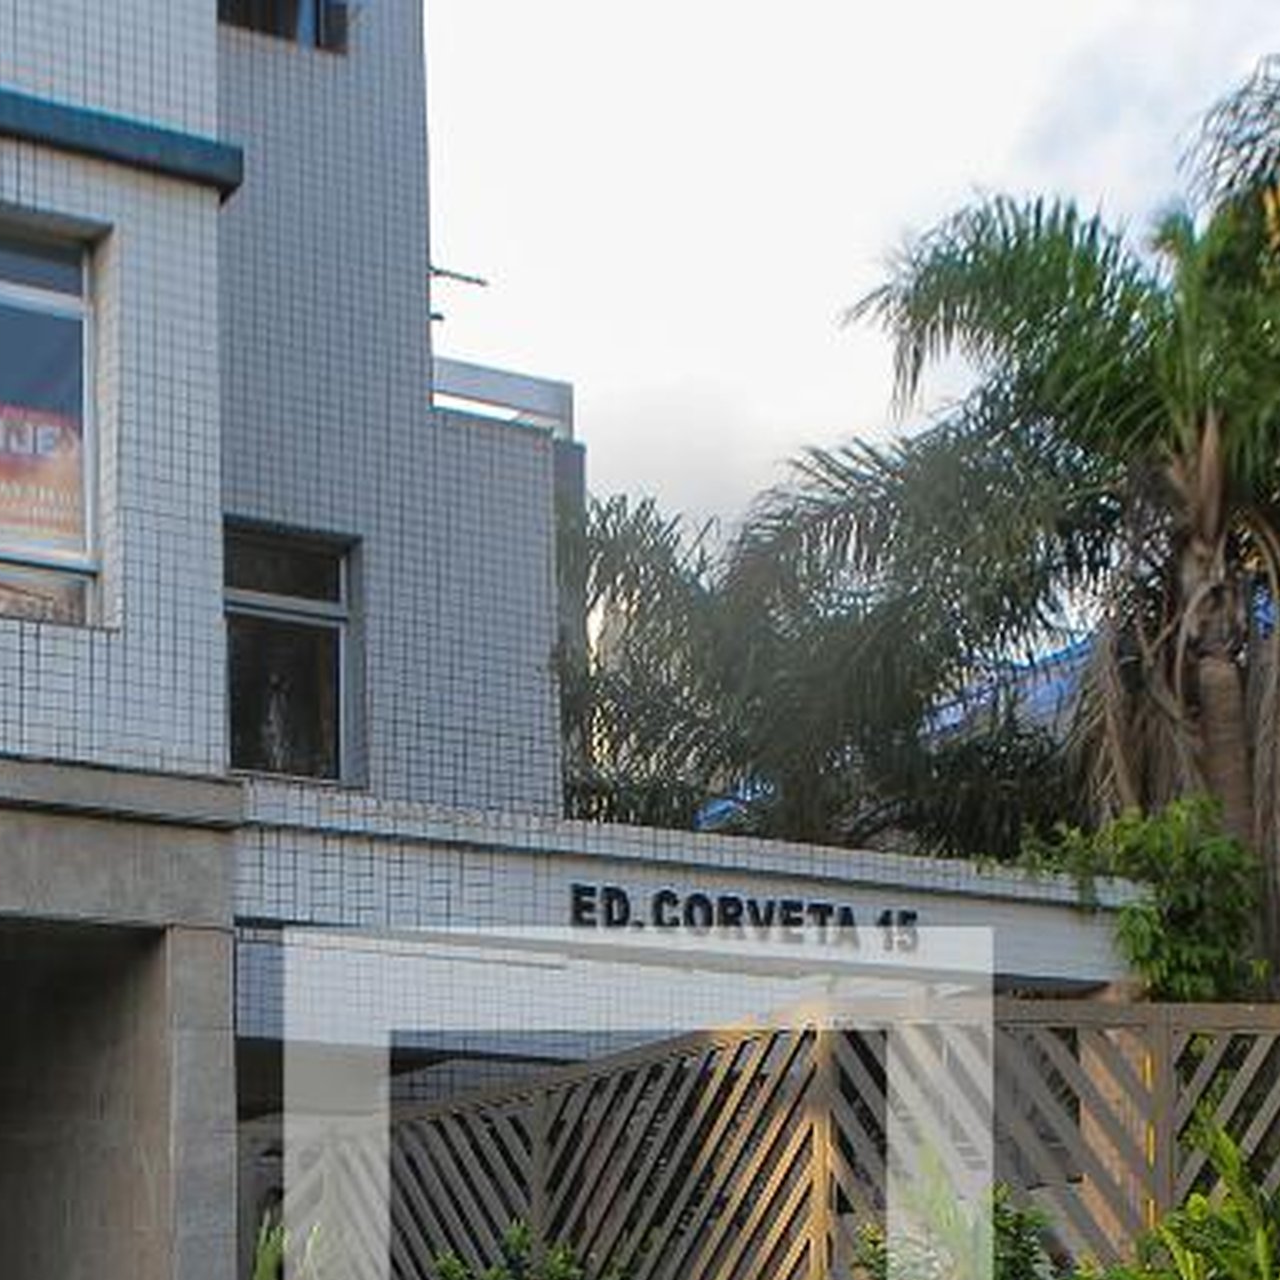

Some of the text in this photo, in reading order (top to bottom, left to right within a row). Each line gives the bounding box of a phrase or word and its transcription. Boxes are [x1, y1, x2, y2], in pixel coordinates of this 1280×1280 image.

[571, 885, 919, 951] ED. CORVETA 15
